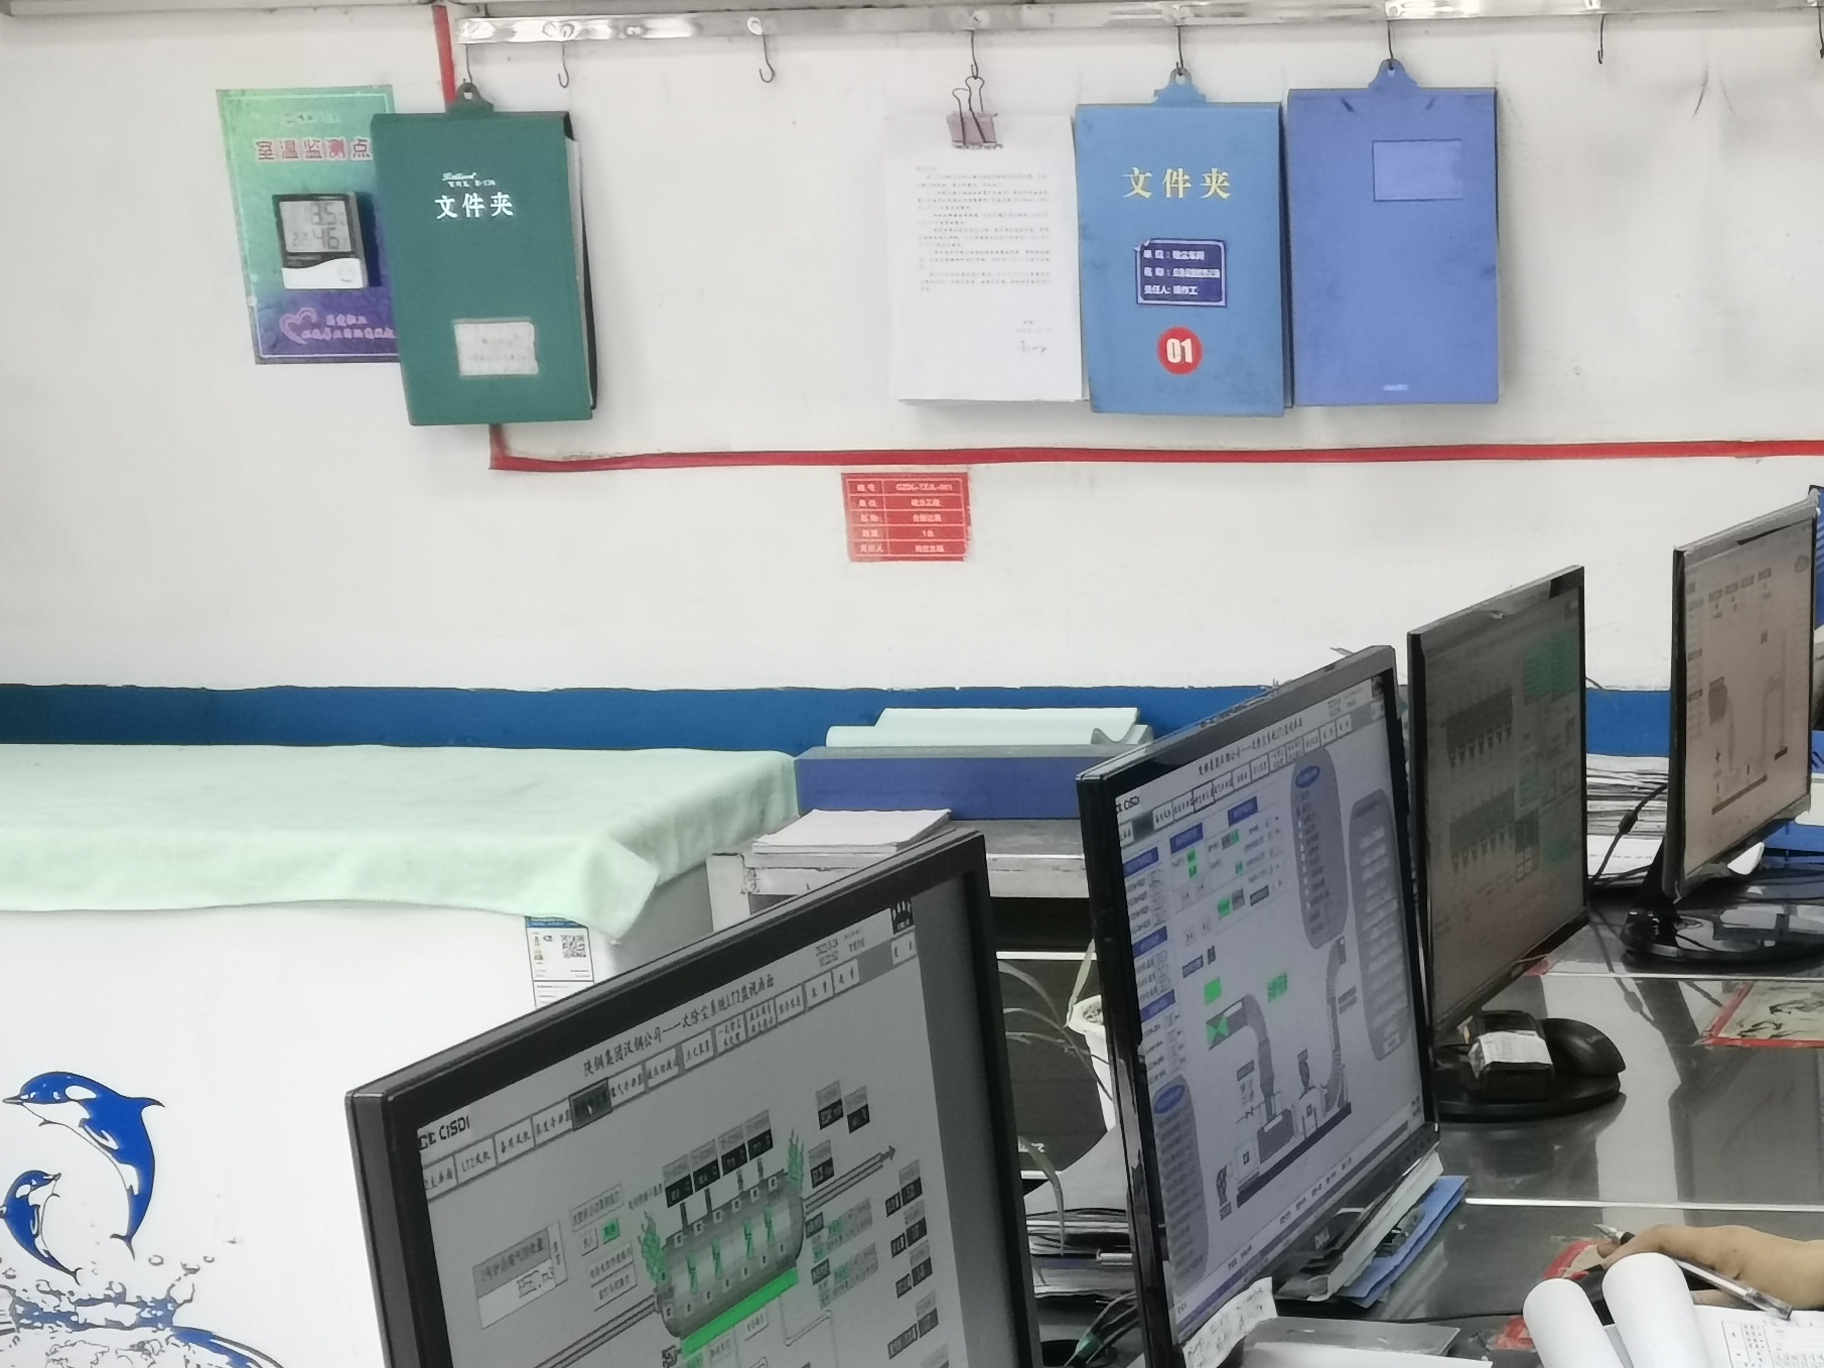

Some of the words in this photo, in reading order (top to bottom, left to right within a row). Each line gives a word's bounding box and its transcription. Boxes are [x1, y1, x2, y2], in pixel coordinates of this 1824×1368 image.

[255, 138, 371, 162] 室温监测点
[1121, 166, 1231, 199] 文件夹
[434, 191, 514, 220] 文件夹
[1166, 337, 1194, 364] 01
[438, 1115, 471, 1141] CISDI
